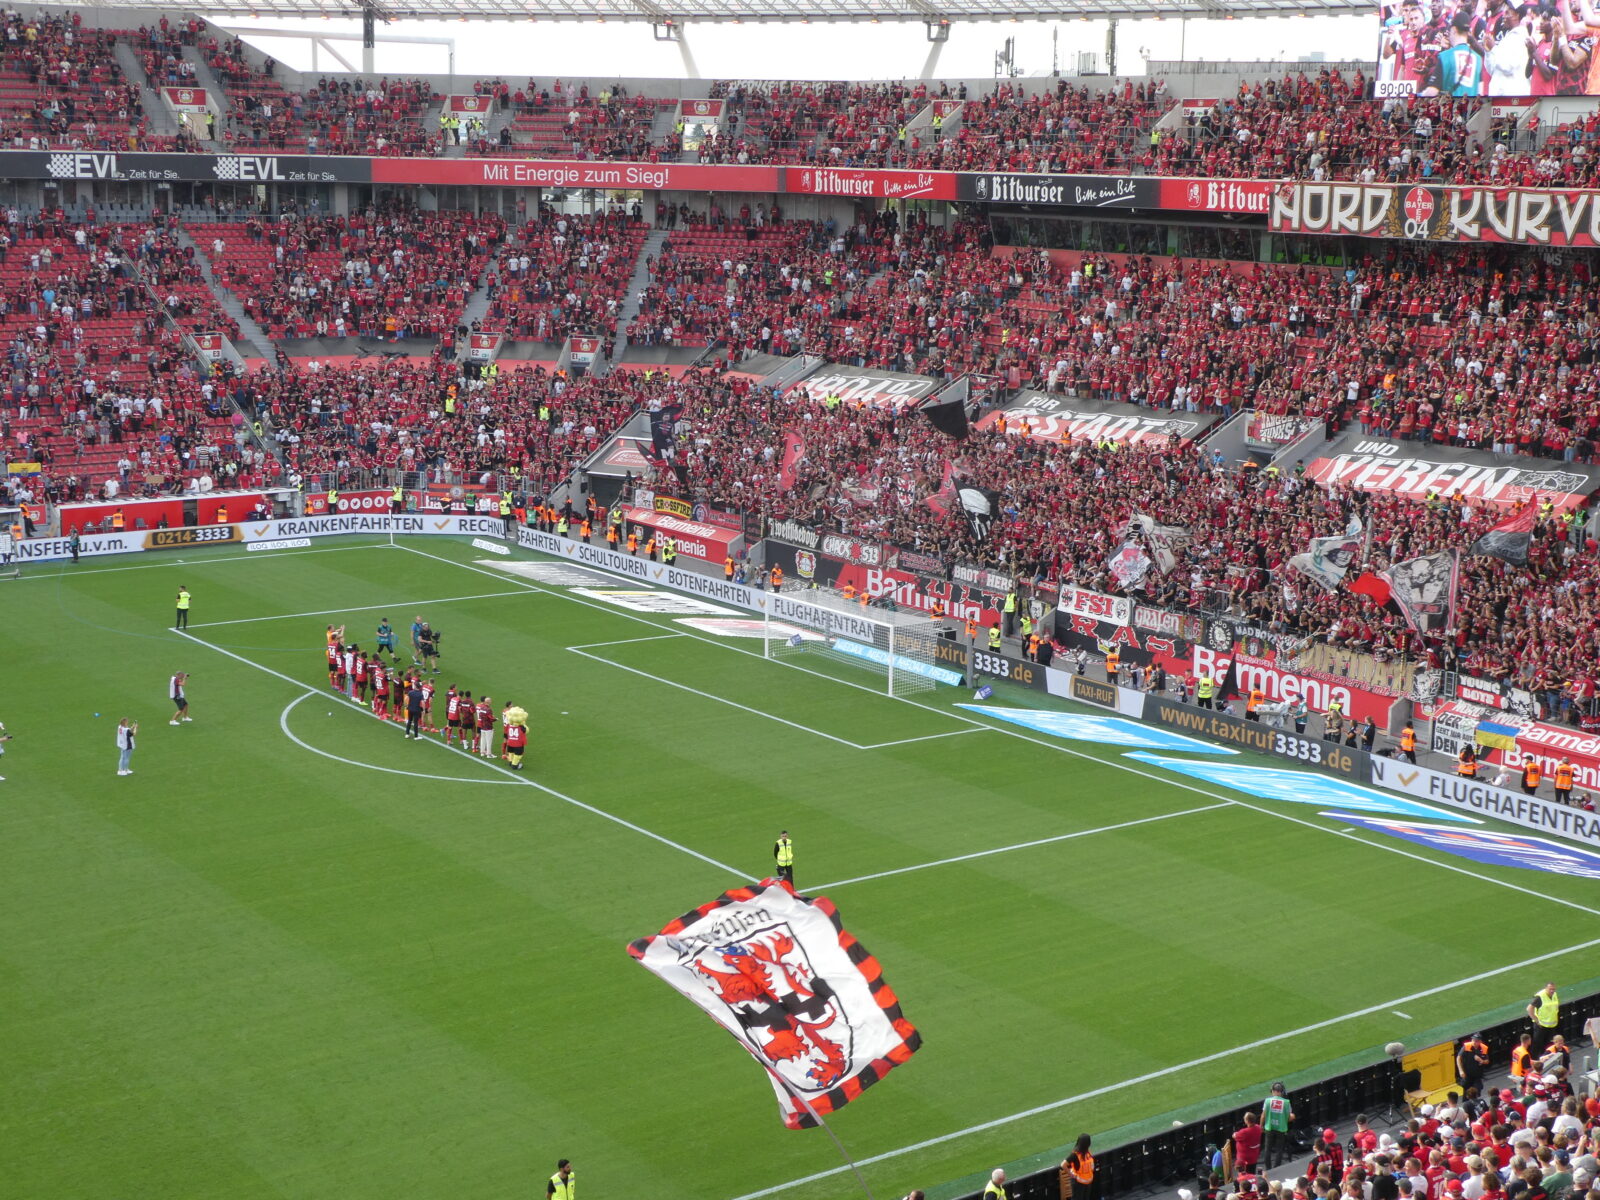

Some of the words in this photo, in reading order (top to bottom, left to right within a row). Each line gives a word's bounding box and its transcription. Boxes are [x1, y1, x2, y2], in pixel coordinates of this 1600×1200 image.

[129, 169, 147, 179] Zeit
[149, 169, 161, 179] für
[163, 170, 180, 179] Sie.
[239, 157, 285, 180] EVL
[289, 171, 306, 181] Zeit
[308, 171, 319, 181] für
[321, 172, 337, 182] Sie.
[483, 164, 509, 181] Mit
[514, 165, 579, 187] Energie
[584, 170, 620, 184] zum
[626, 167, 669, 188] Sieg!
[814, 170, 874, 196] Bitburger
[884, 179, 902, 194] Bitte
[917, 174, 933, 188] Bit
[991, 175, 1064, 203] Bitburger
[1075, 184, 1096, 204] Bitte
[1097, 187, 1113, 197] ein
[1115, 179, 1136, 194] Bit
[1273, 183, 1394, 232] NORD
[1404, 219, 1429, 239] 04
[1405, 200, 1433, 210] BAYER
[1024, 396, 1061, 410] FÜR
[1040, 411, 1168, 444] STADT
[1353, 440, 1399, 456] UND
[1328, 455, 1521, 499] VEREIN
[157, 527, 230, 545] 0214-3333
[278, 516, 424, 537] KRANKENFAHRTEN
[656, 515, 716, 538] Barmenia
[16, 541, 71, 558] NSFER
[78, 537, 128, 552] u.v.m.
[656, 531, 707, 557] Bamenia
[579, 546, 648, 577] SCHULTOUREN
[669, 570, 751, 605] BOTENFAHRTEN
[867, 569, 981, 622] Barmnia
[1075, 591, 1114, 618] FSI
[1077, 683, 1114, 704] TAXI-RUF
[1458, 675, 1501, 695] YOUNG
[508, 727, 519, 737] 04
[1437, 712, 1462, 730] DER
[1160, 705, 1352, 773] www.taxiruf3333.de
[1435, 735, 1458, 756] DEN
